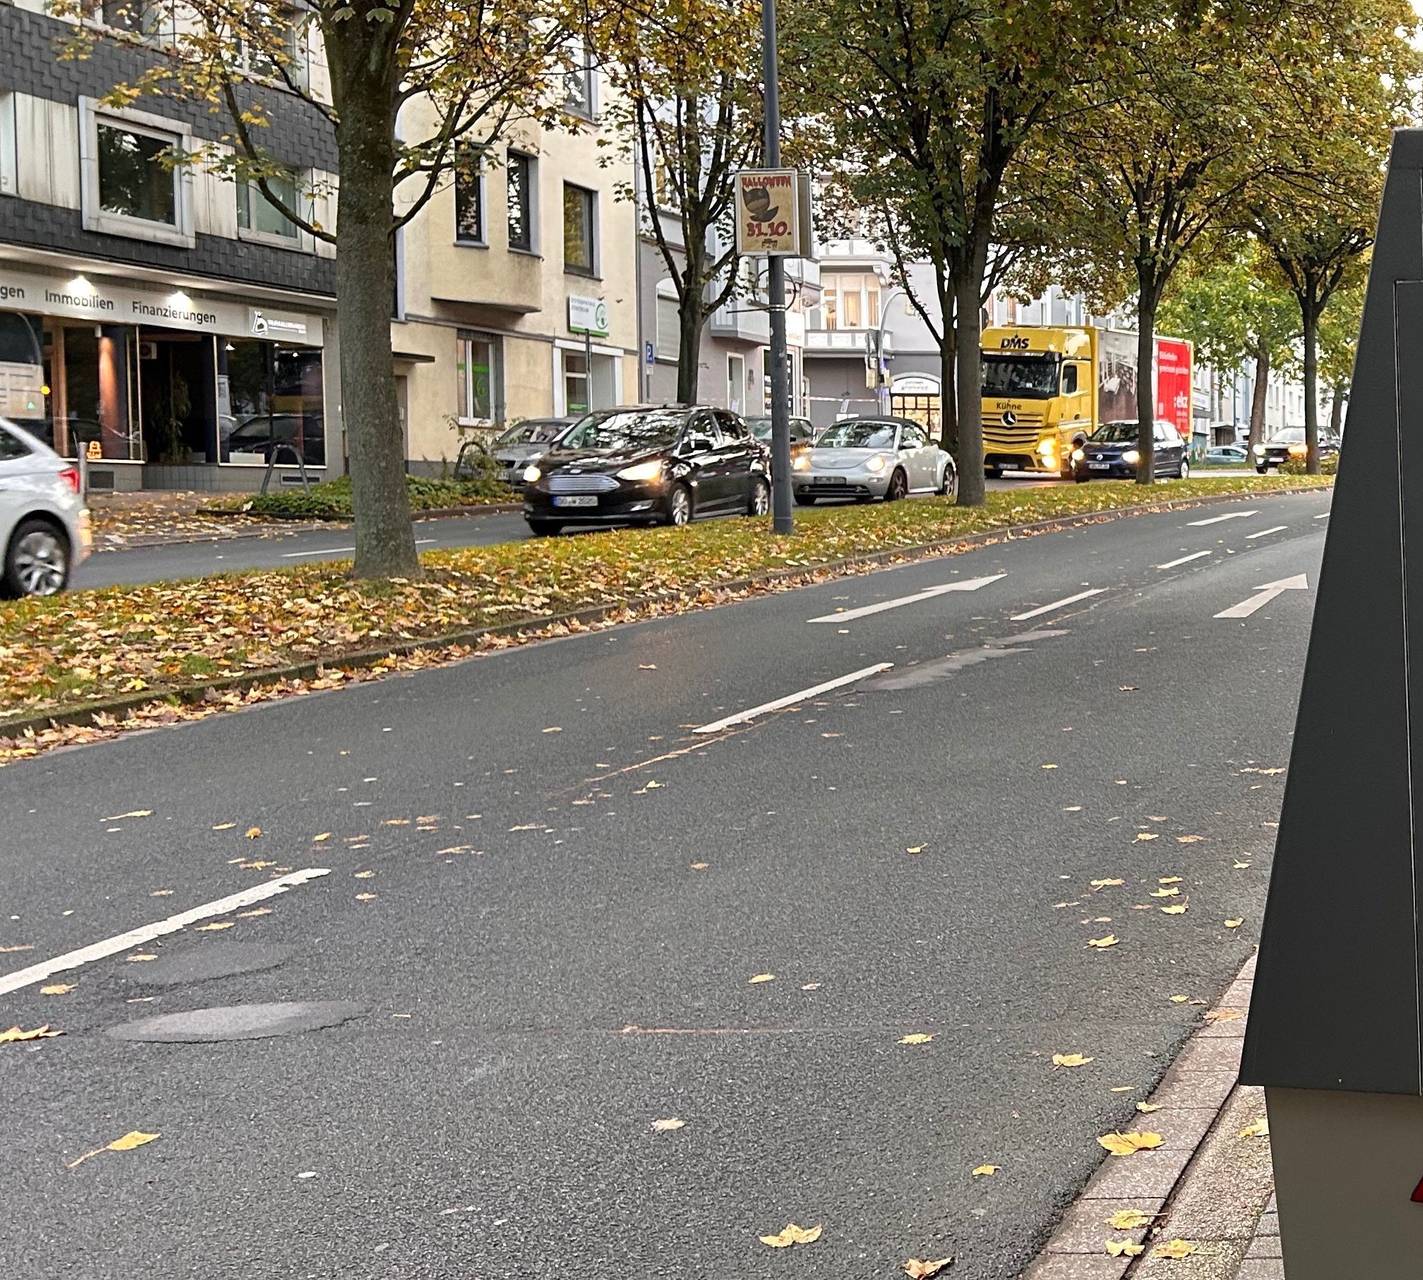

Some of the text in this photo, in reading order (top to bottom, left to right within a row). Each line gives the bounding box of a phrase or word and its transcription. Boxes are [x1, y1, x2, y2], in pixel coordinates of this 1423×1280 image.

[746, 221, 792, 237] 31.10.
[45, 288, 114, 310] Immobilien
[132, 301, 216, 324] Finanzierungen
[1000, 337, 1030, 349] DMS
[996, 401, 1023, 410] Kühne
